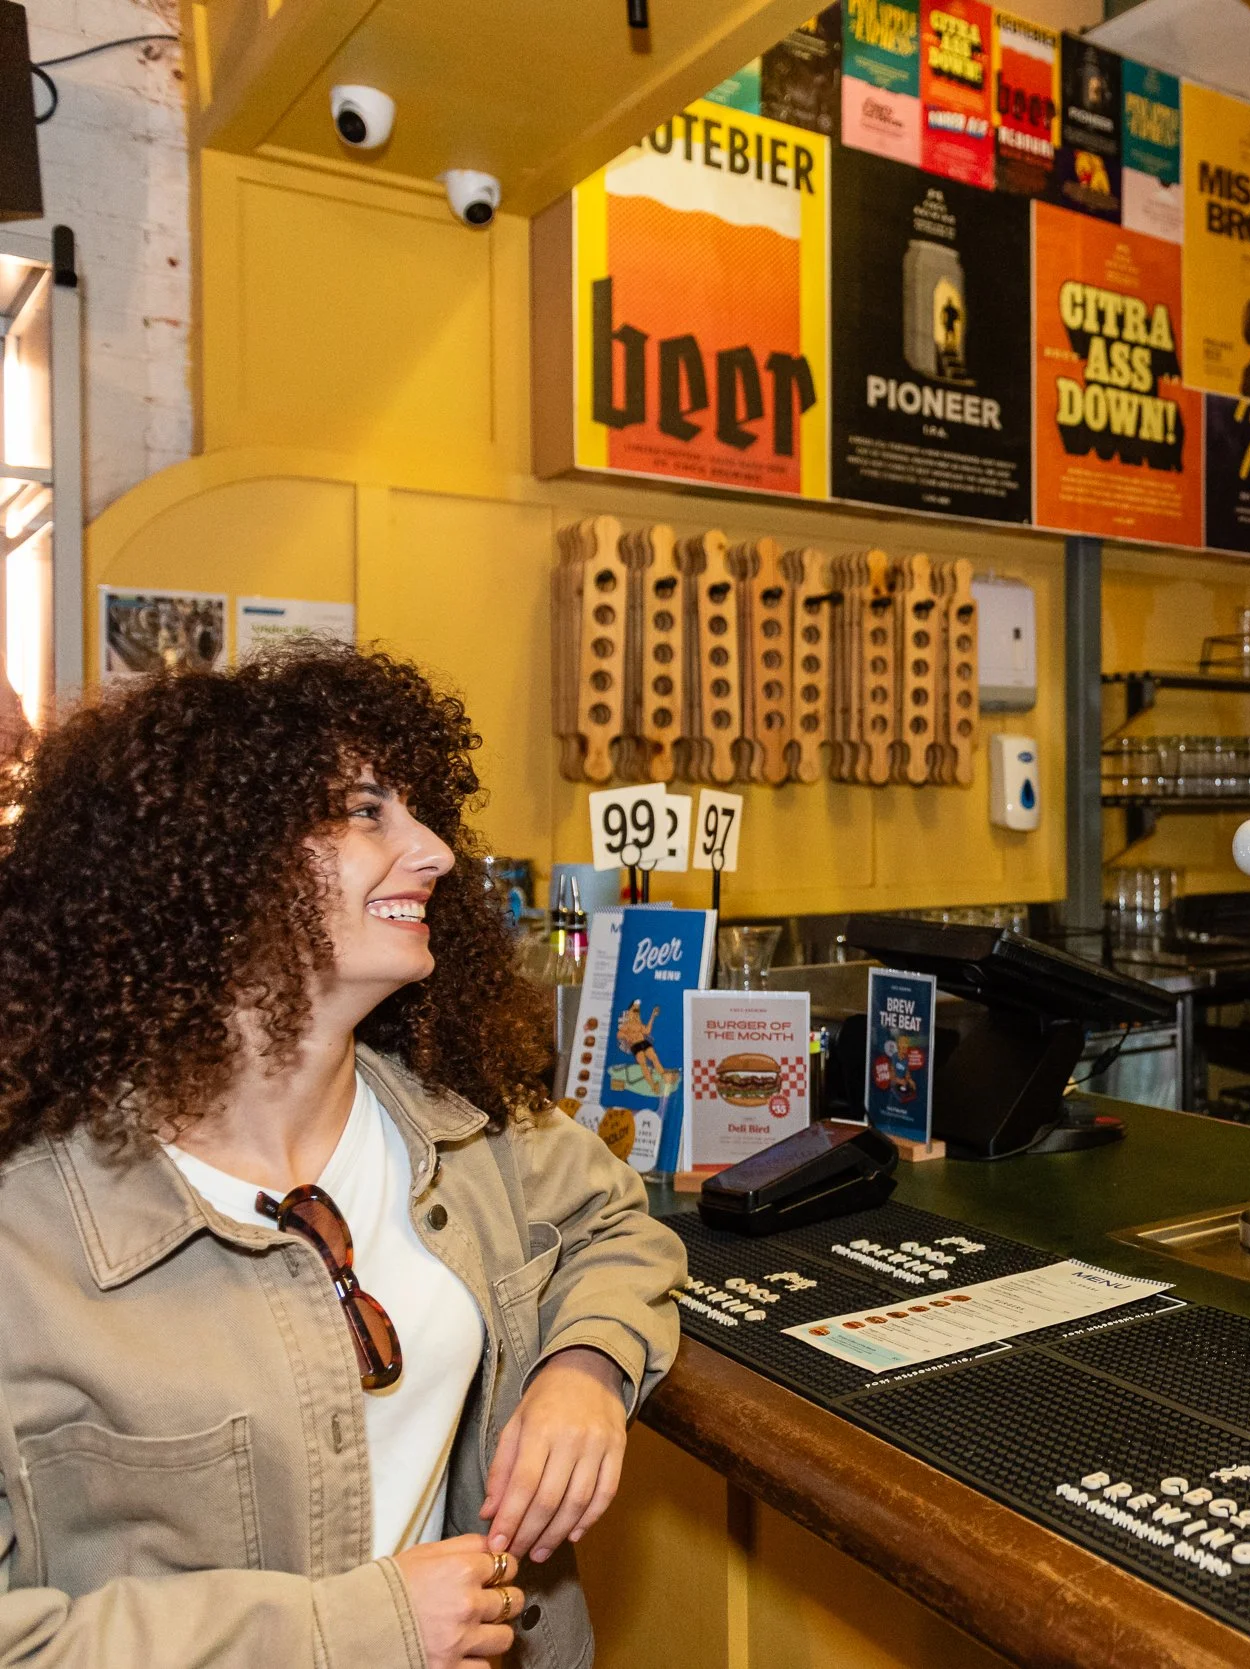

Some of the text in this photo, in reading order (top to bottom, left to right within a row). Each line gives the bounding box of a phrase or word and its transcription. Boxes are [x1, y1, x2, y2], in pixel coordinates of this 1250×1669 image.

[636, 112, 816, 195] UTEBIER
[1060, 280, 1174, 352] CITRA
[592, 276, 817, 457] beer
[1084, 335, 1152, 393] ASS
[866, 374, 1003, 431] PIONEER
[1056, 376, 1177, 445] DOWN!
[603, 799, 655, 854] 99
[703, 804, 735, 856] 97
[632, 937, 683, 974] Beer
[653, 969, 682, 981] MENU
[880, 1011, 922, 1032] THE BEAT
[886, 997, 915, 1015] BREW
[704, 1031, 794, 1041] THE MONTH
[706, 1020, 792, 1031] BURGER OF
[728, 1124, 770, 1133] Deli Bird
[1071, 1271, 1132, 1290] MENU
[894, 1362, 950, 1381] MELBOURNE
